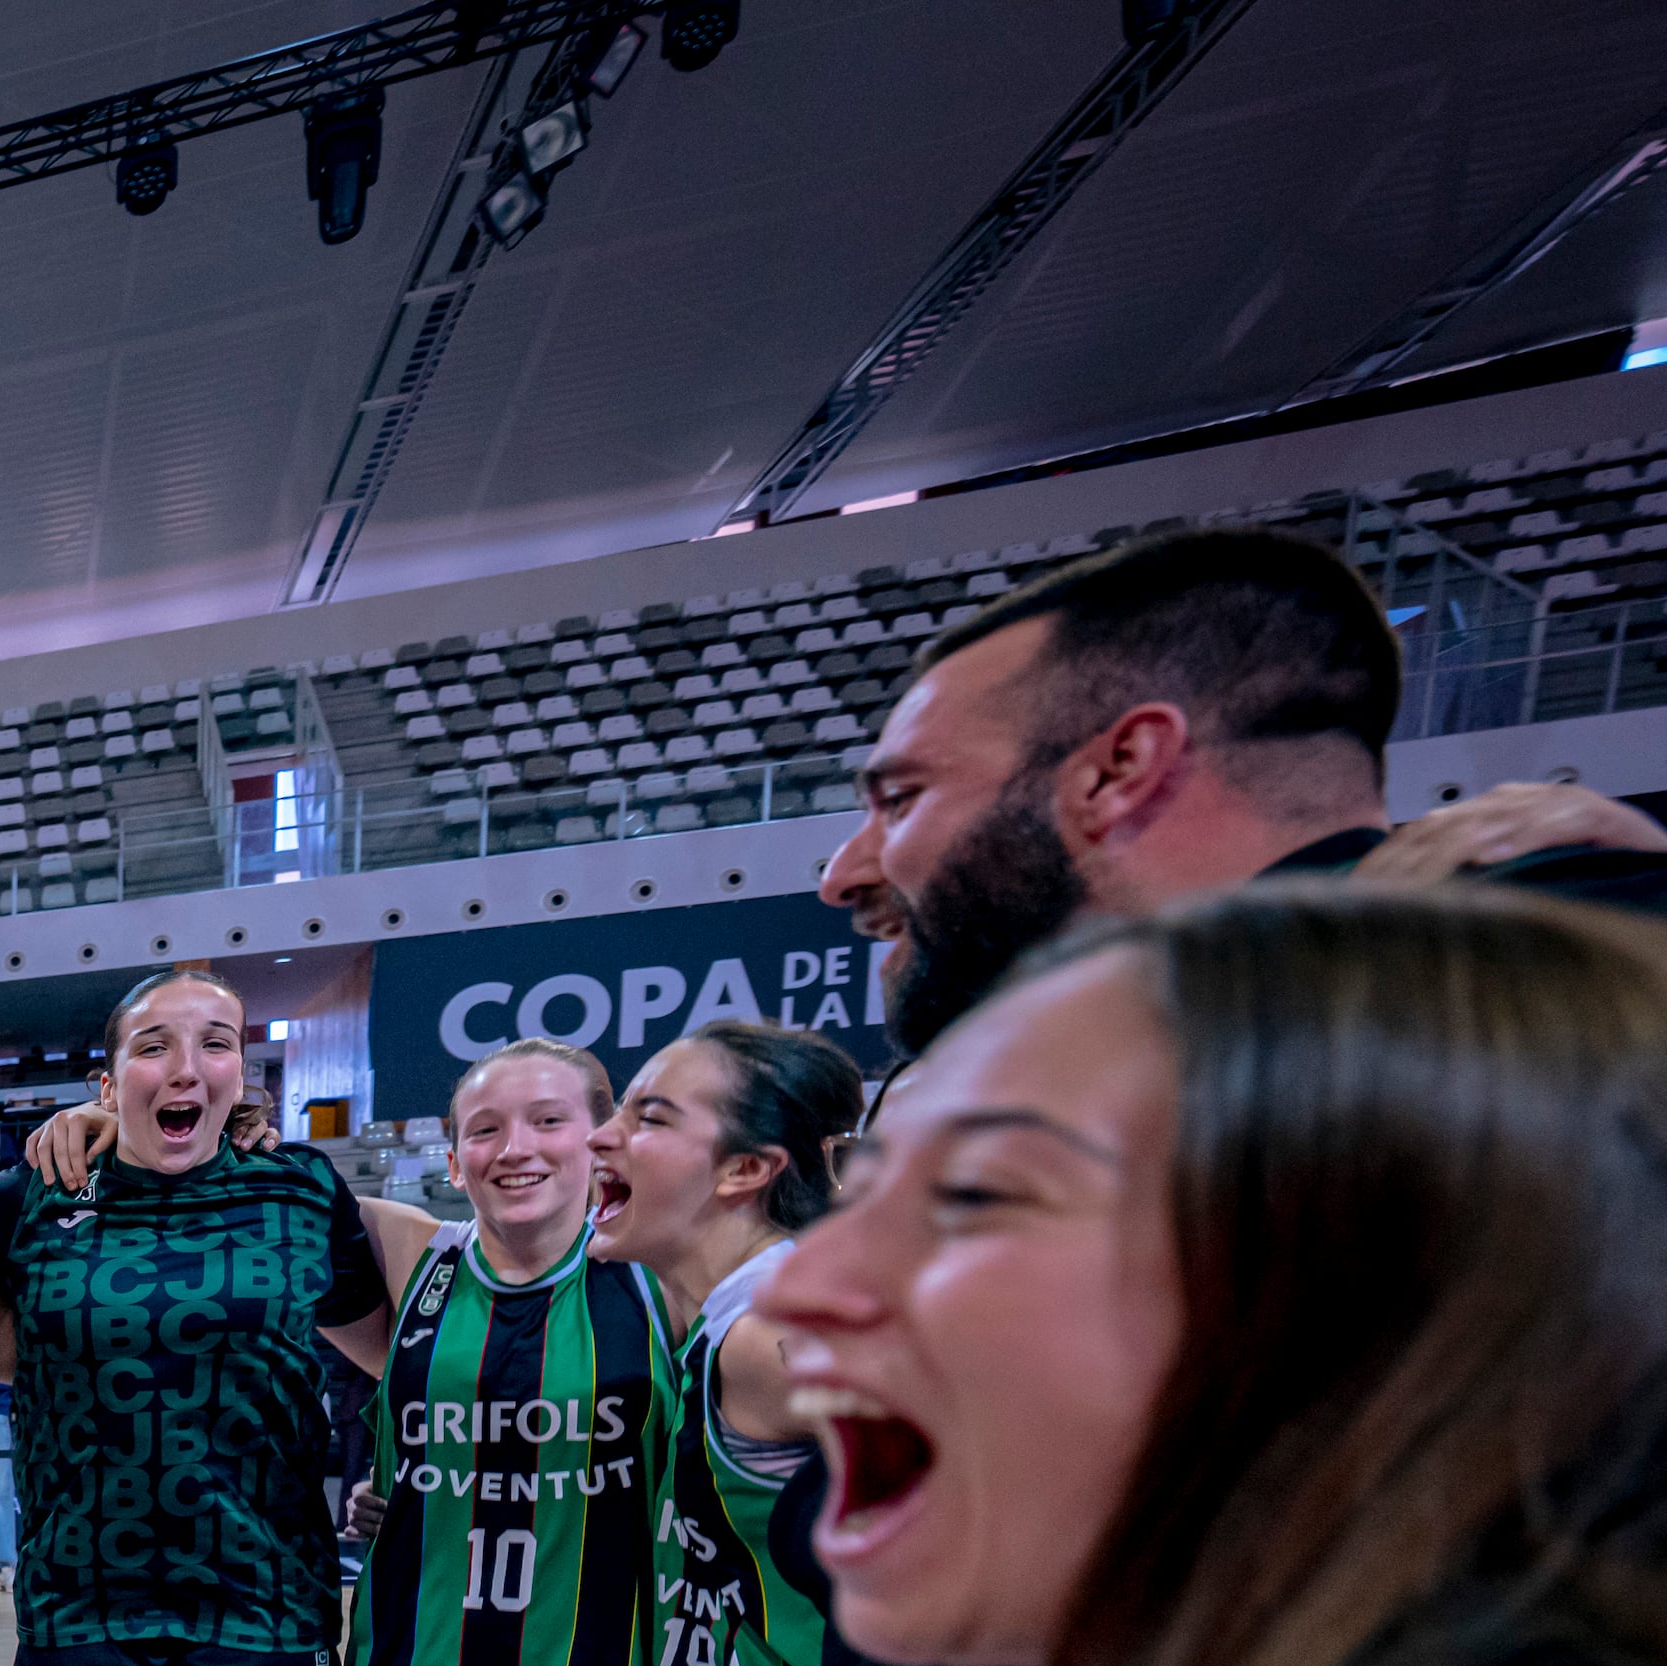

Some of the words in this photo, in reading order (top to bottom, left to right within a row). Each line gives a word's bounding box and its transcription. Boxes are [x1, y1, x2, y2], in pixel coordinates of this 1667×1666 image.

[781, 946, 853, 990] DE
[439, 957, 762, 1063] COPA
[780, 991, 852, 1031] LA
[402, 1395, 625, 1446] GRIFOLS
[395, 1456, 635, 1502] JOVENTUT
[462, 1528, 537, 1613] 10
